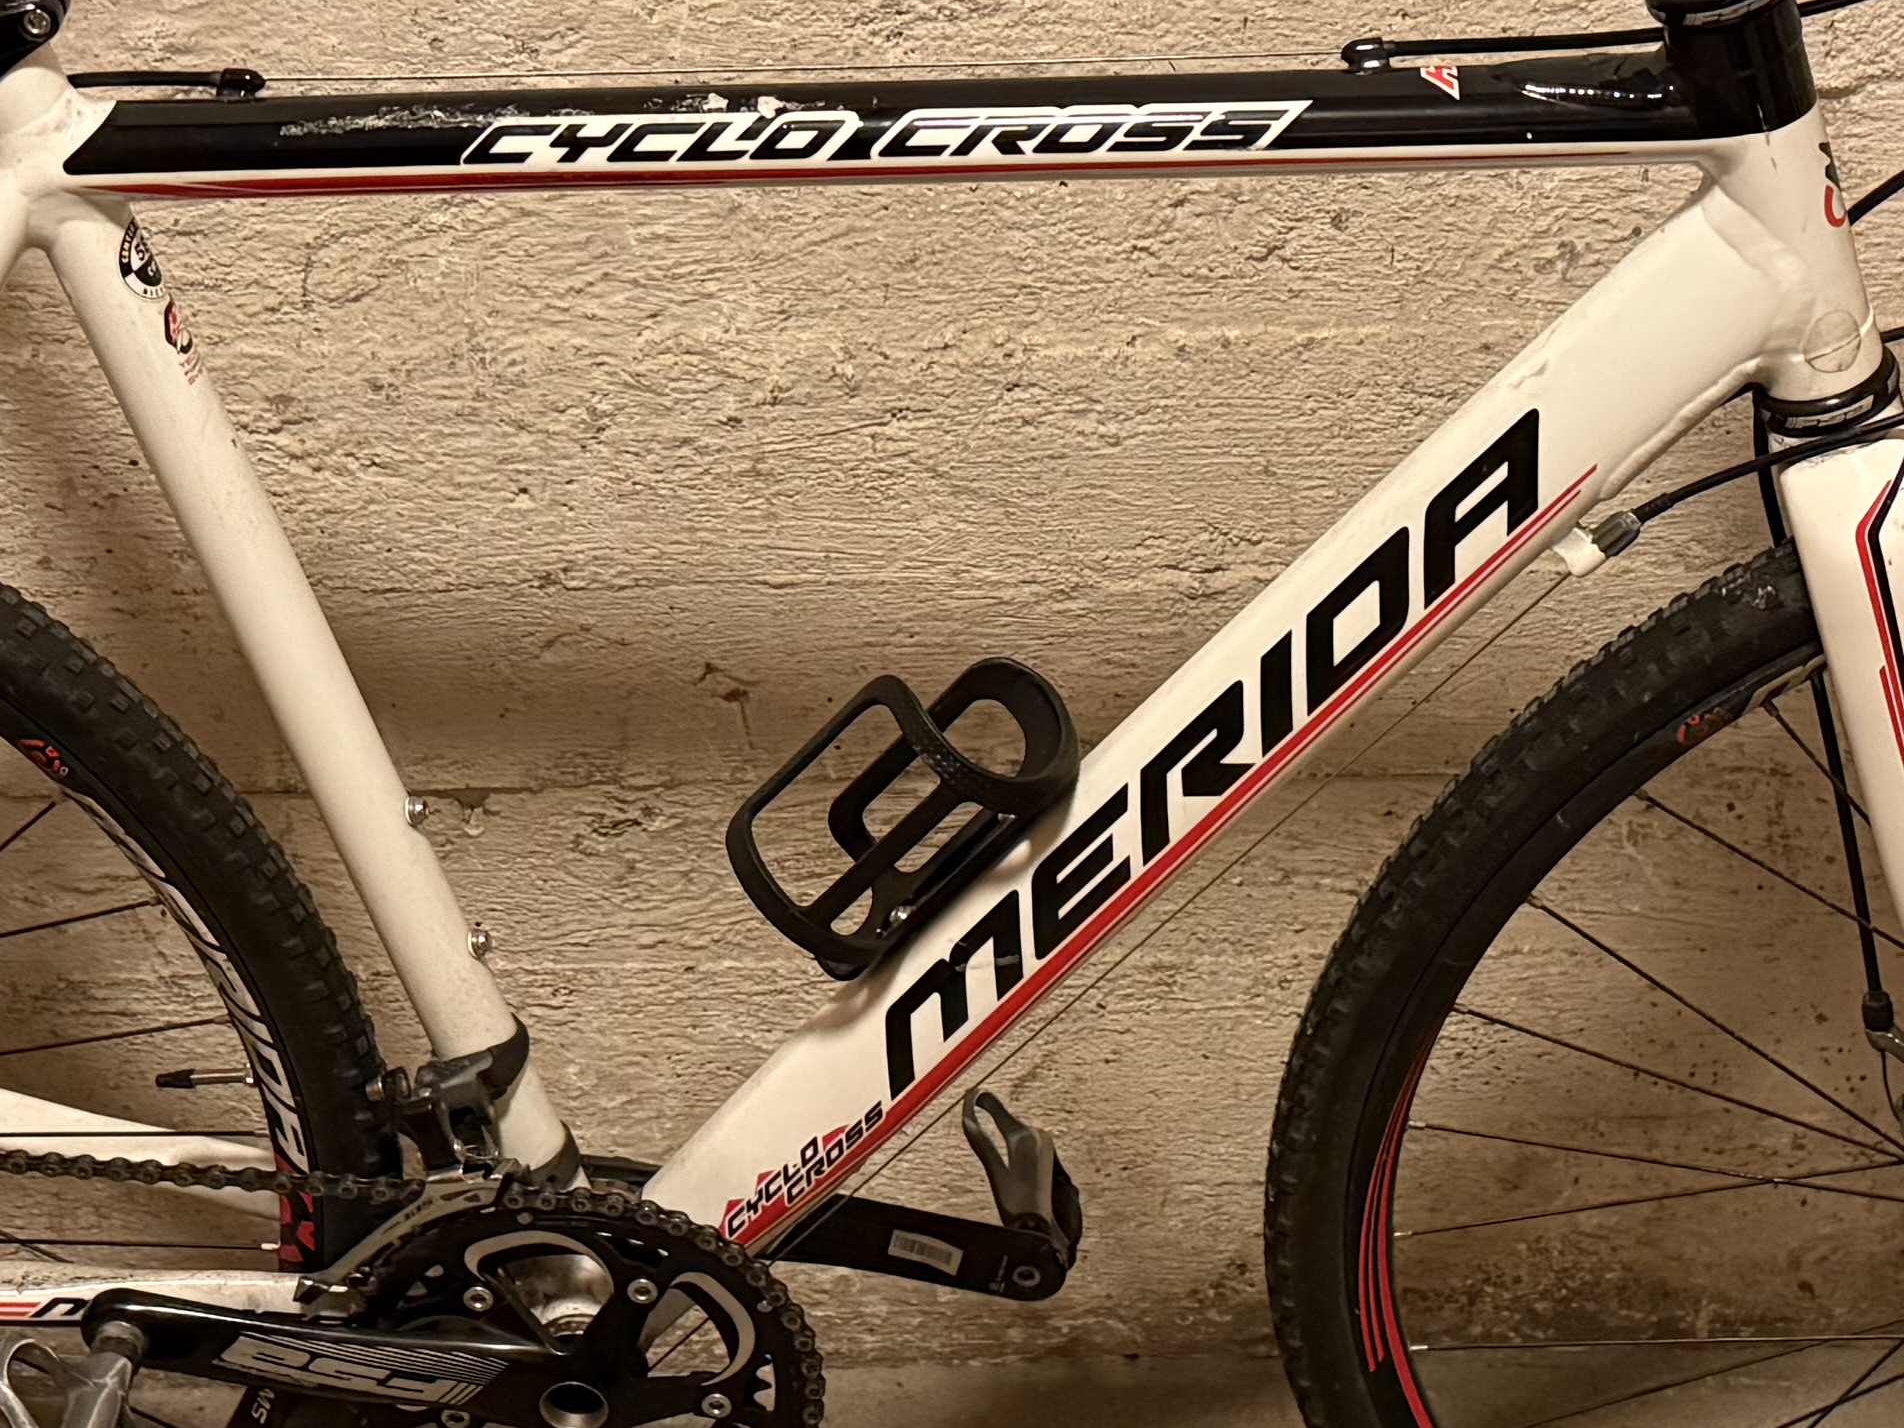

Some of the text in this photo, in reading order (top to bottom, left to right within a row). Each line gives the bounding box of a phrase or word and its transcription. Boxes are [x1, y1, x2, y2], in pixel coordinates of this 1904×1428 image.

[468, 109, 1301, 164] CYCLO CROSS
[885, 407, 1540, 1100] MERIDA
[728, 1136, 818, 1238] CYCLO
[787, 1100, 884, 1205] CROSS
